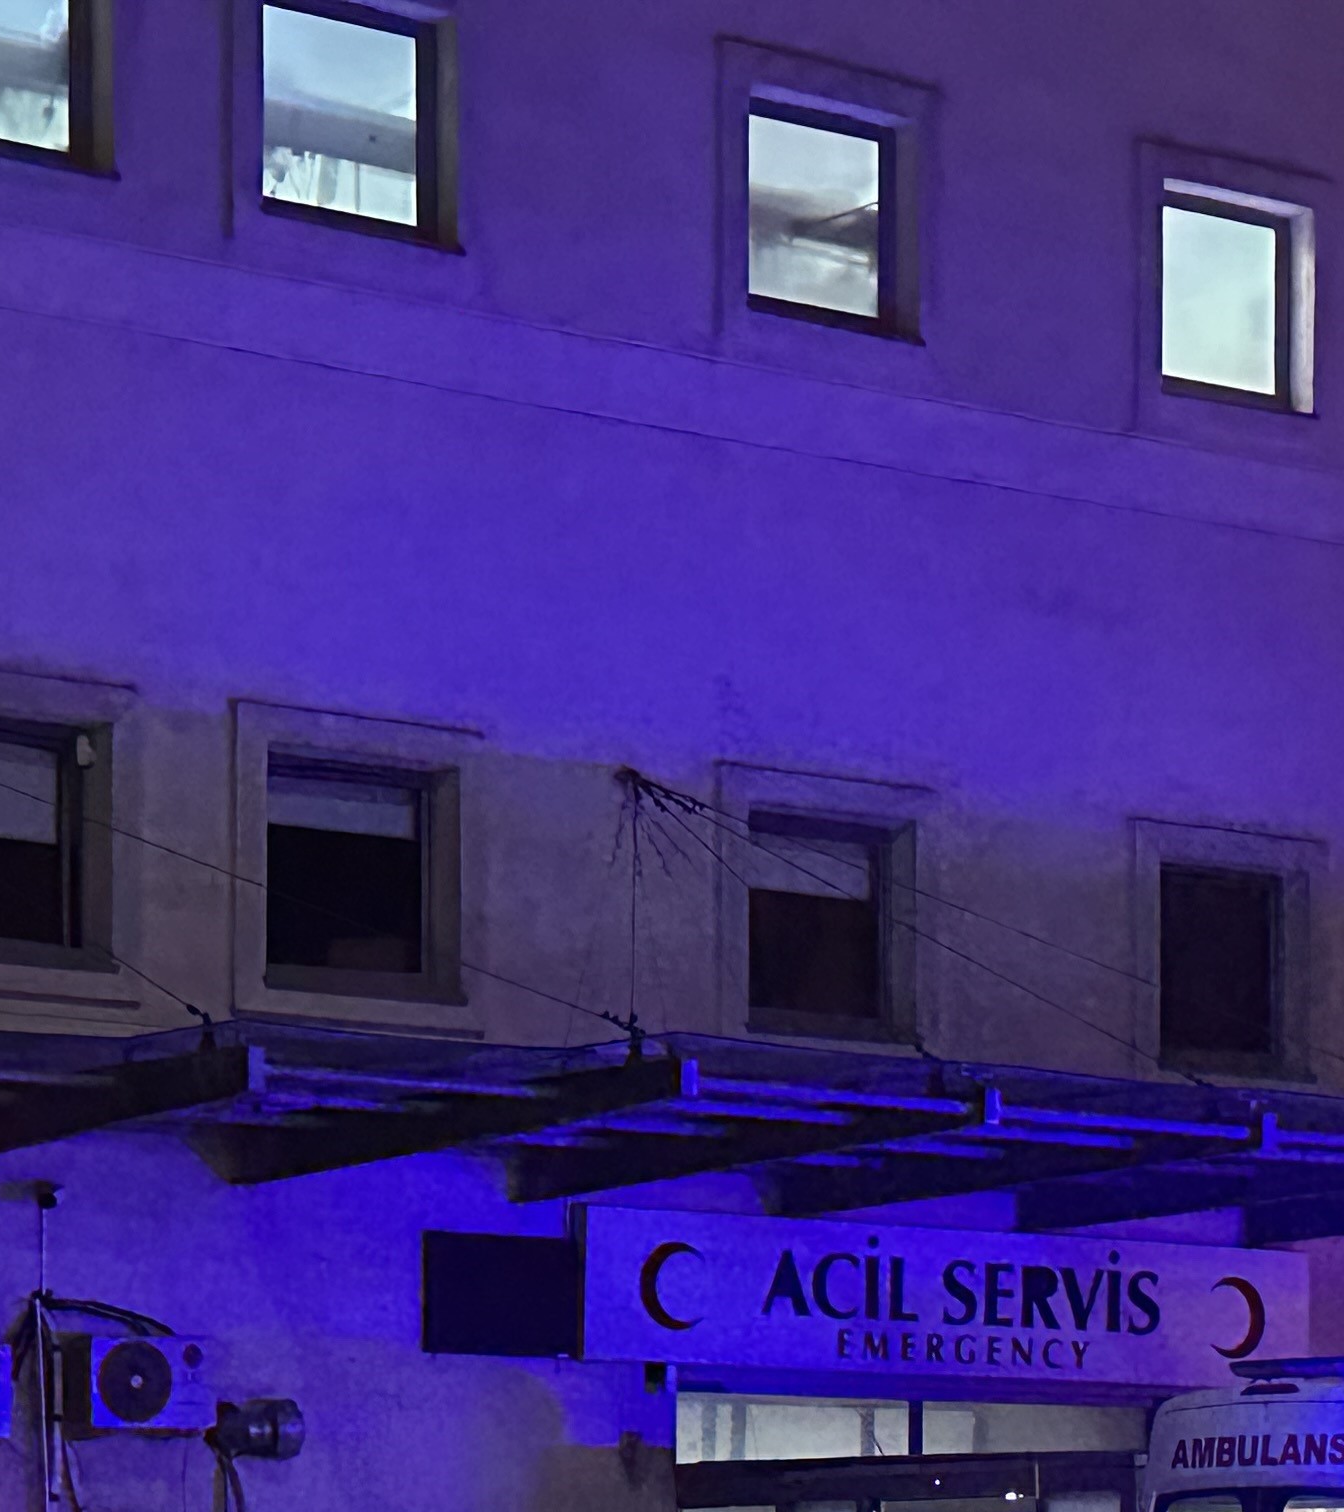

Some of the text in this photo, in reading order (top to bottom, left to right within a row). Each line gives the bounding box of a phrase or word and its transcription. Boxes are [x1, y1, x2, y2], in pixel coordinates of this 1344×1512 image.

[761, 1235, 1161, 1336] ACİL SERVİS
[837, 1327, 1090, 1369] EMERGENCY
